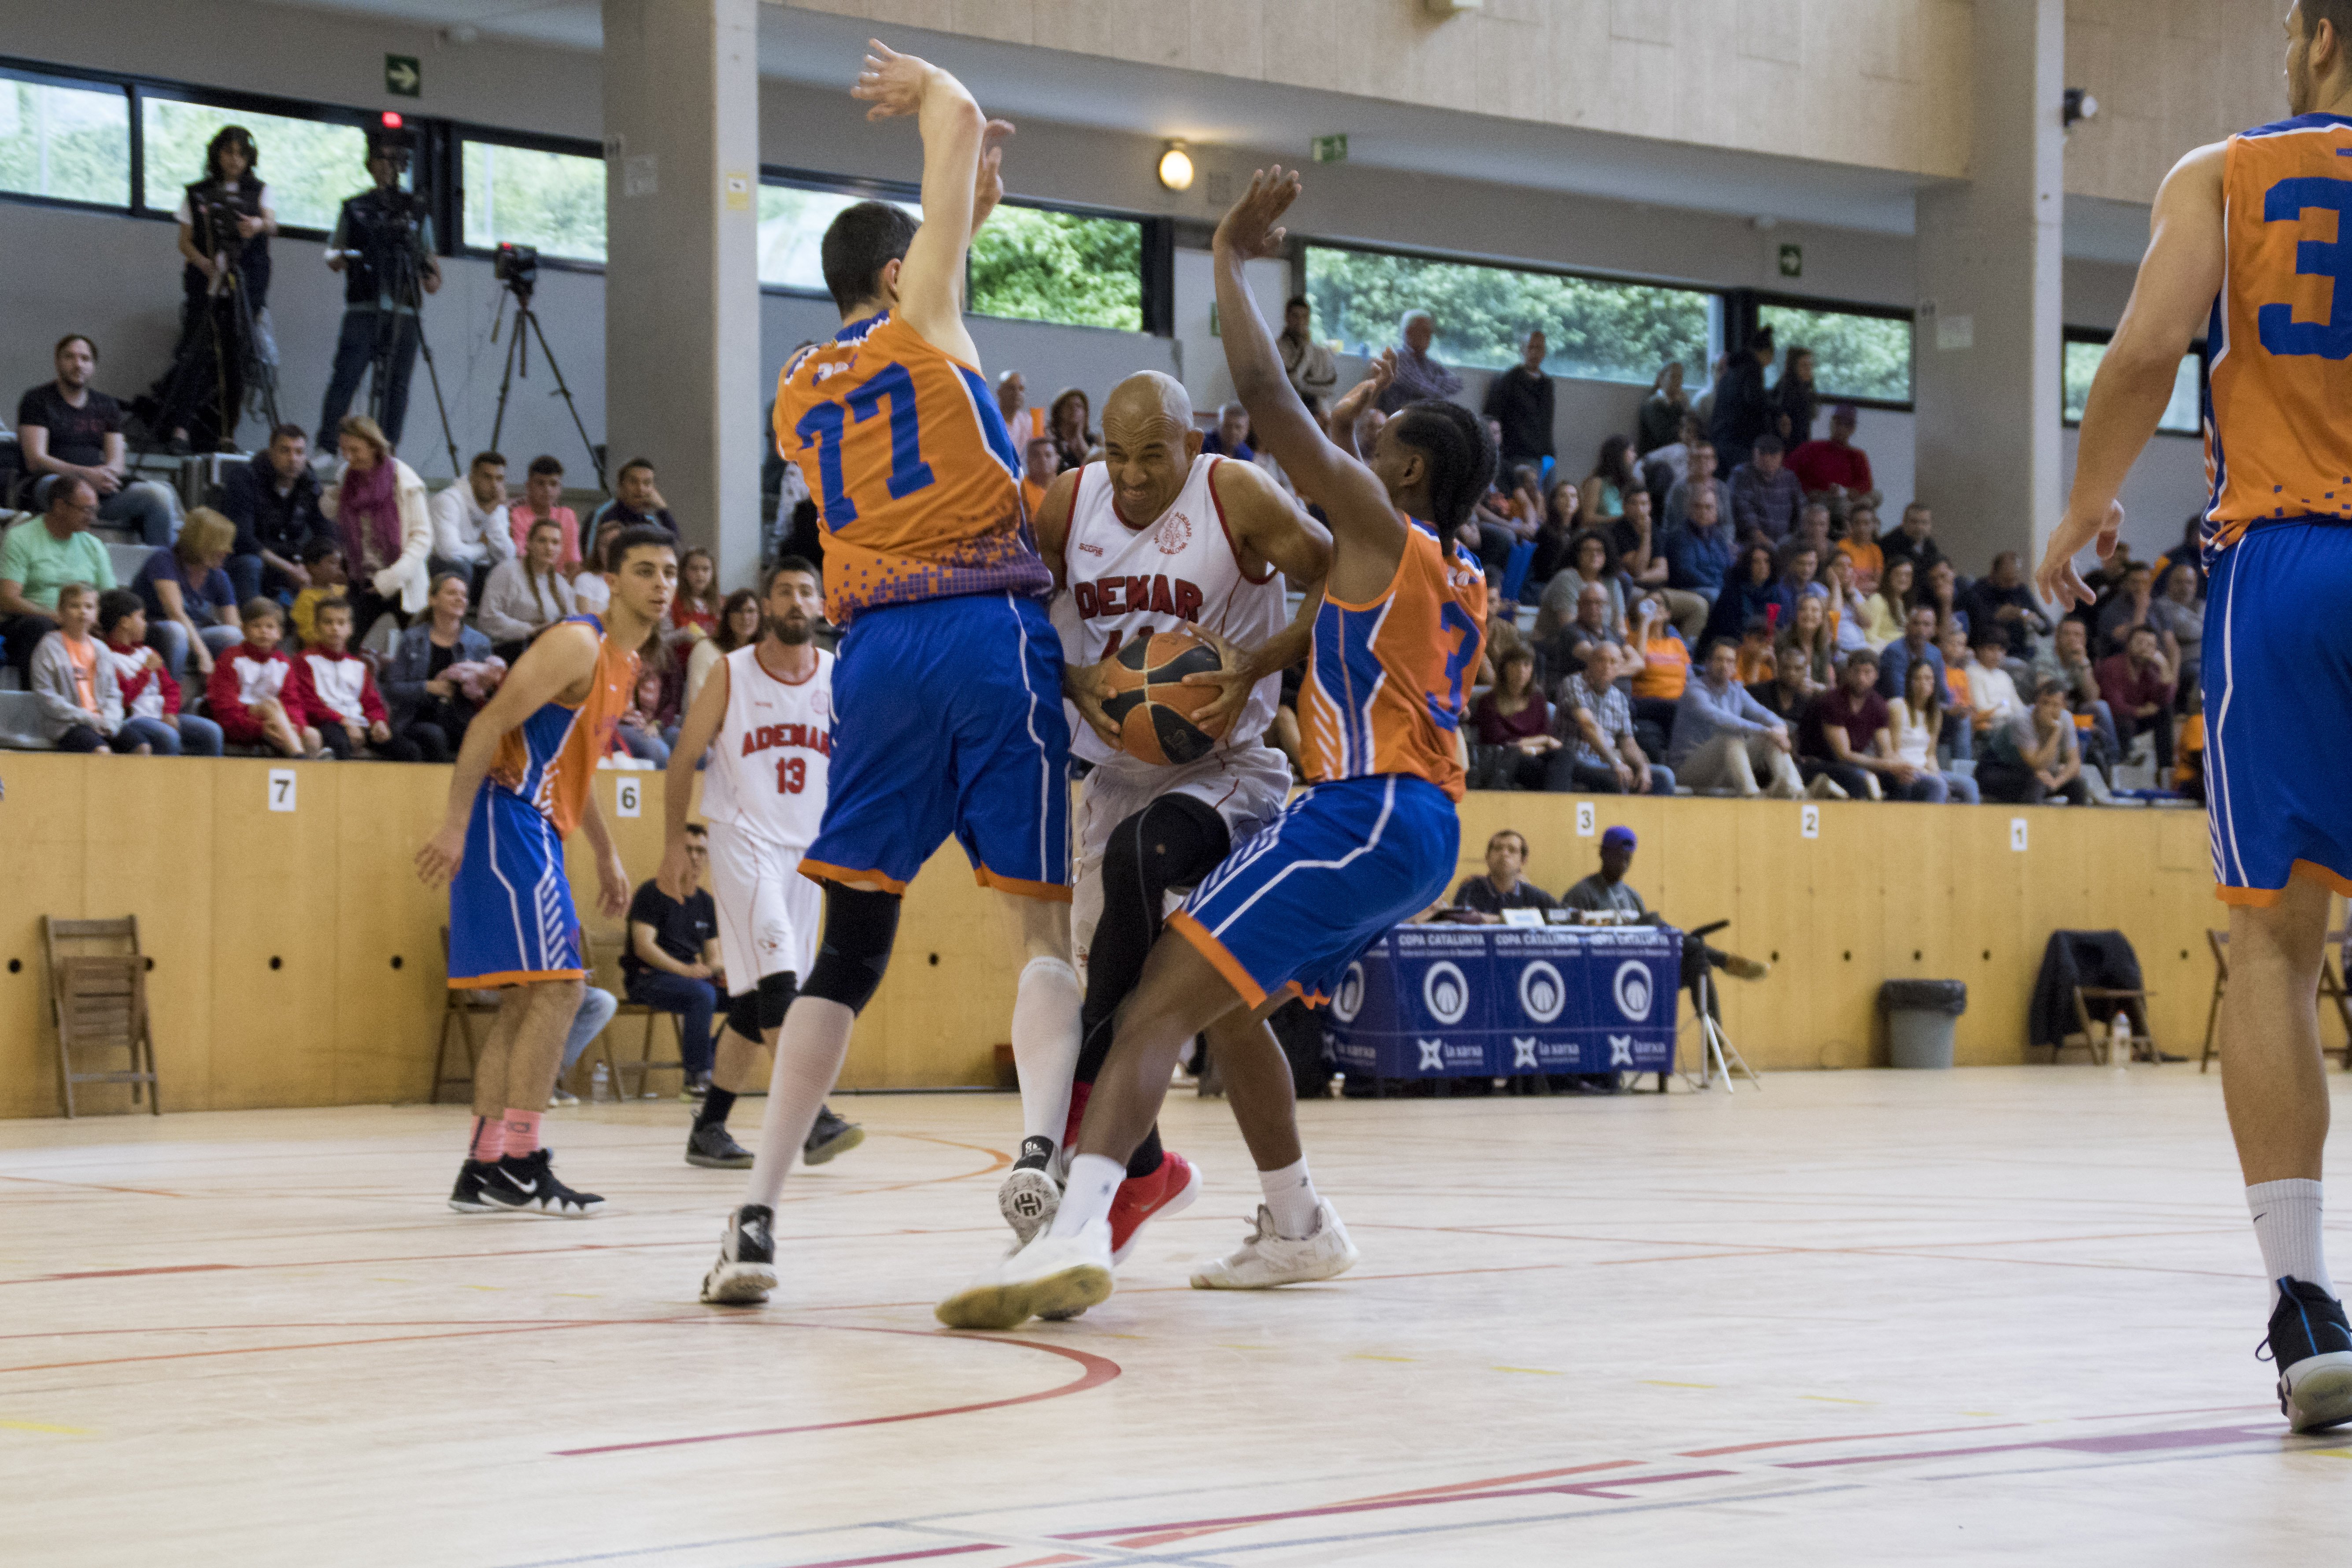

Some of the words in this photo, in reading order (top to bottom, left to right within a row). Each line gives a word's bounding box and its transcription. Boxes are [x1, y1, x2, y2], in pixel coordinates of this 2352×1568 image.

[2258, 177, 2352, 360] 3
[1074, 573, 1203, 624] DEMAR
[1425, 601, 1480, 732] 3
[775, 757, 807, 795] 13
[275, 779, 291, 802] 7
[621, 787, 636, 810] 6
[1582, 810, 1591, 829] 3
[1806, 813, 1816, 831] 2
[2016, 828, 2023, 843] 1
[1398, 934, 1425, 946] COPA
[1427, 934, 1485, 946] CATALUNYA
[1495, 934, 1521, 945] COPA
